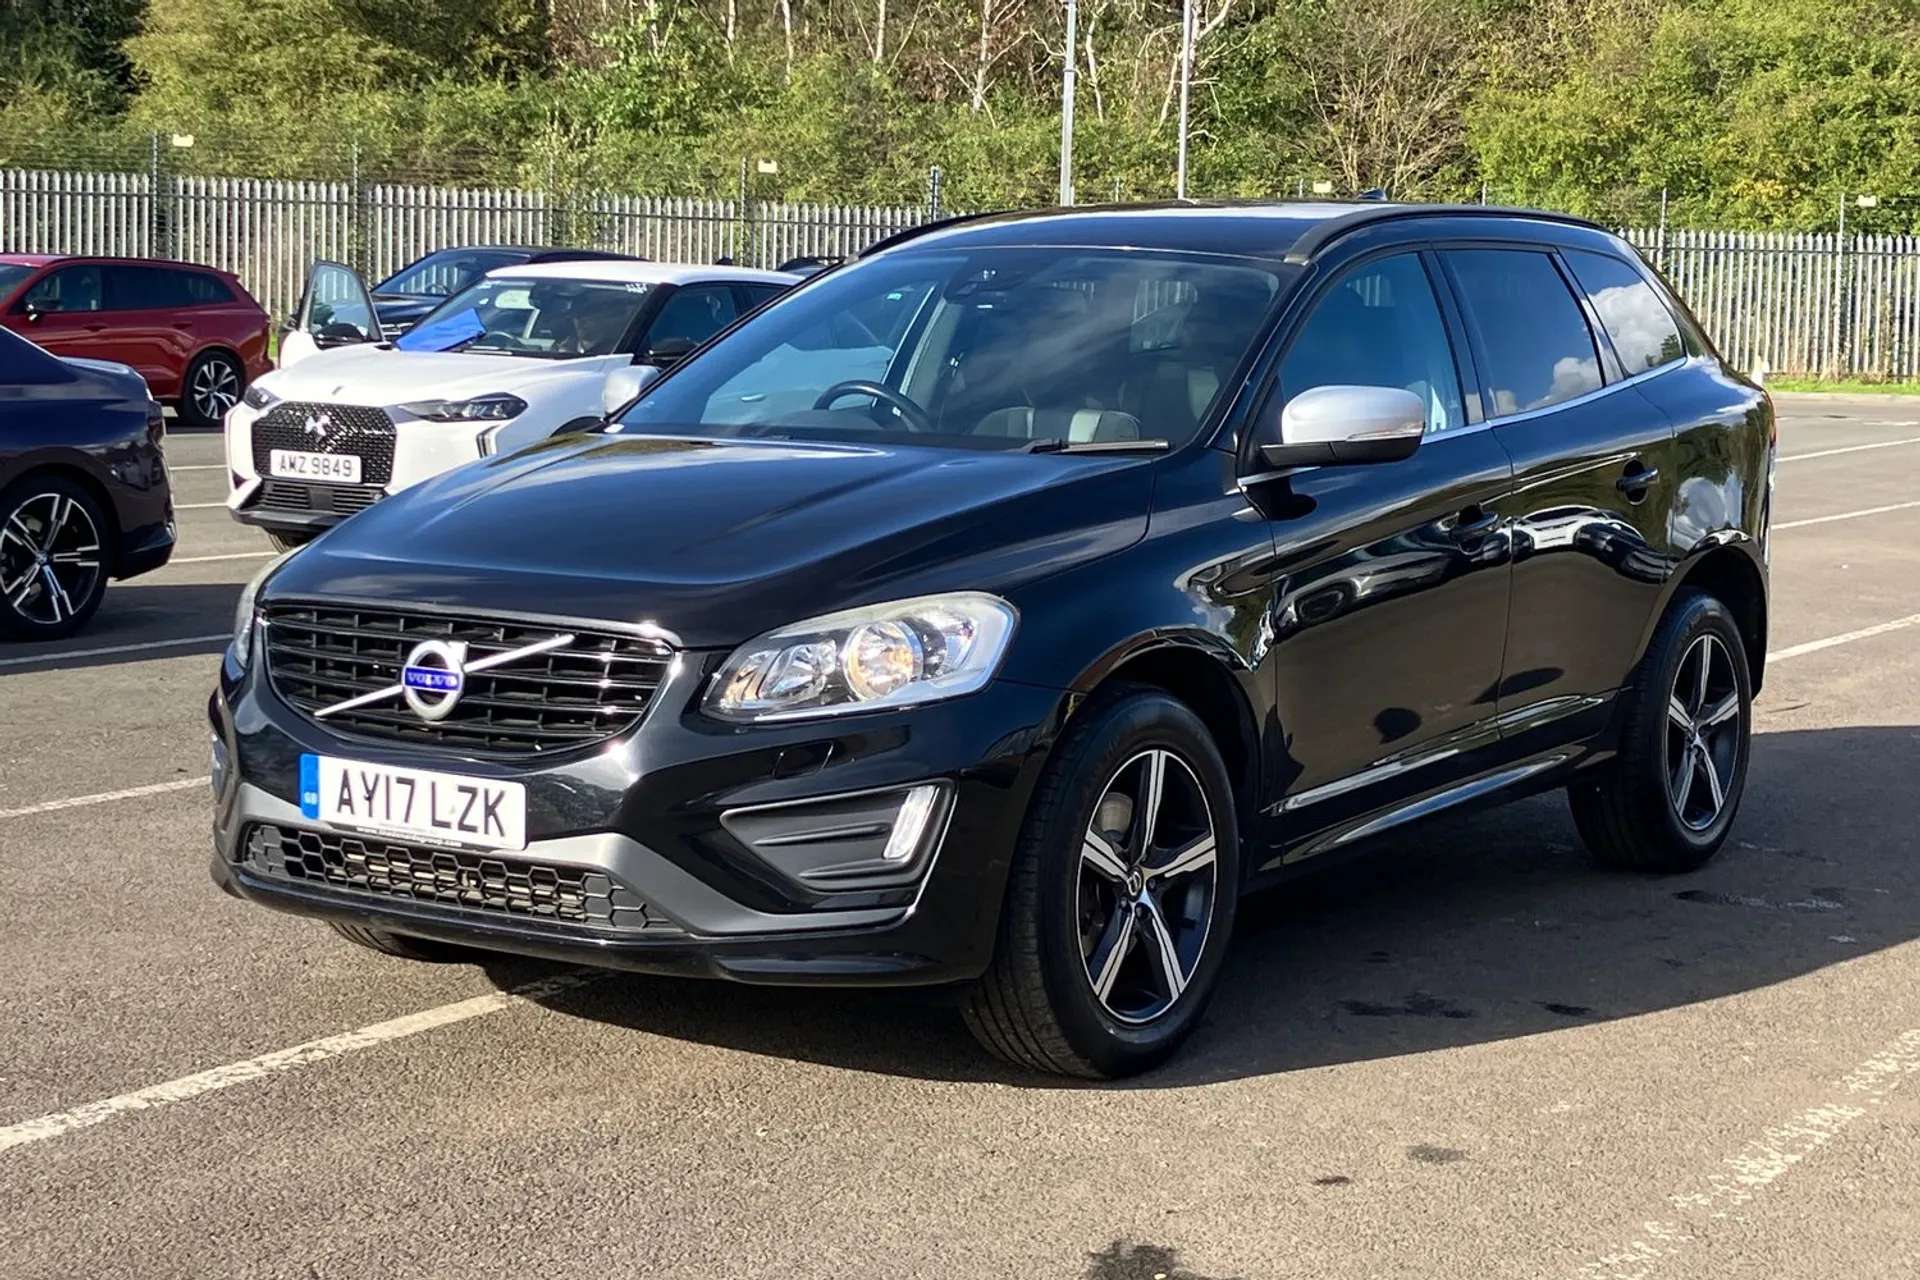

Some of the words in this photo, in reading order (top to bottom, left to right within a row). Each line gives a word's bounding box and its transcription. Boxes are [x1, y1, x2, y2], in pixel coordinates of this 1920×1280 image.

[311, 456, 352, 477] 9849
[407, 672, 458, 687] VOLVO
[337, 768, 415, 823] AY17
[431, 781, 505, 837] LZK
